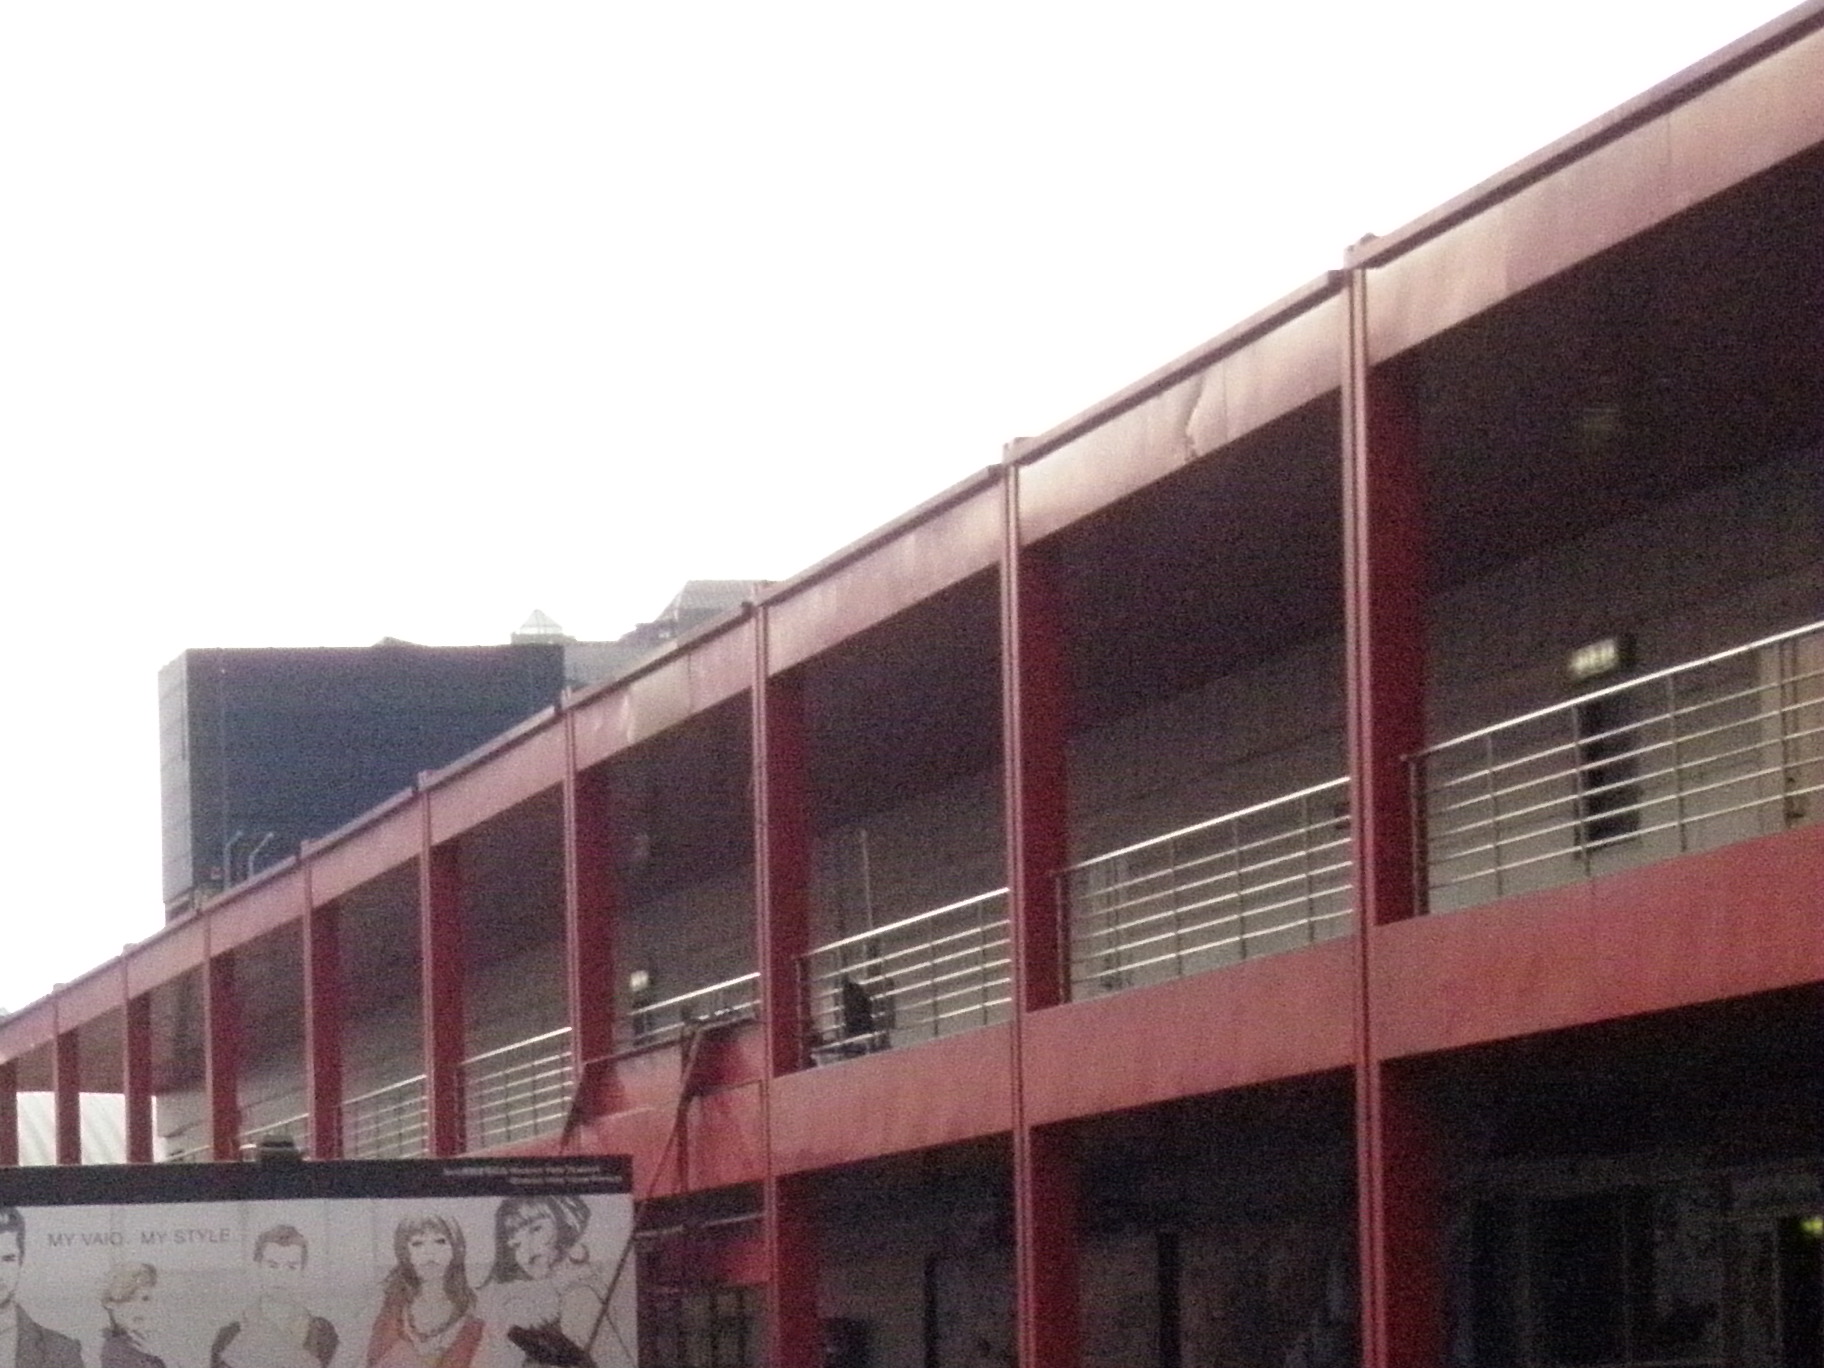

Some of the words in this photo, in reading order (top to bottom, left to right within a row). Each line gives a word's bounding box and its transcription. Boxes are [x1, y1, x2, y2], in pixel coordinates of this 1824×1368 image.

[47, 1232, 76, 1248] MY
[140, 1230, 168, 1246] MY
[173, 1227, 231, 1245] STYLE
